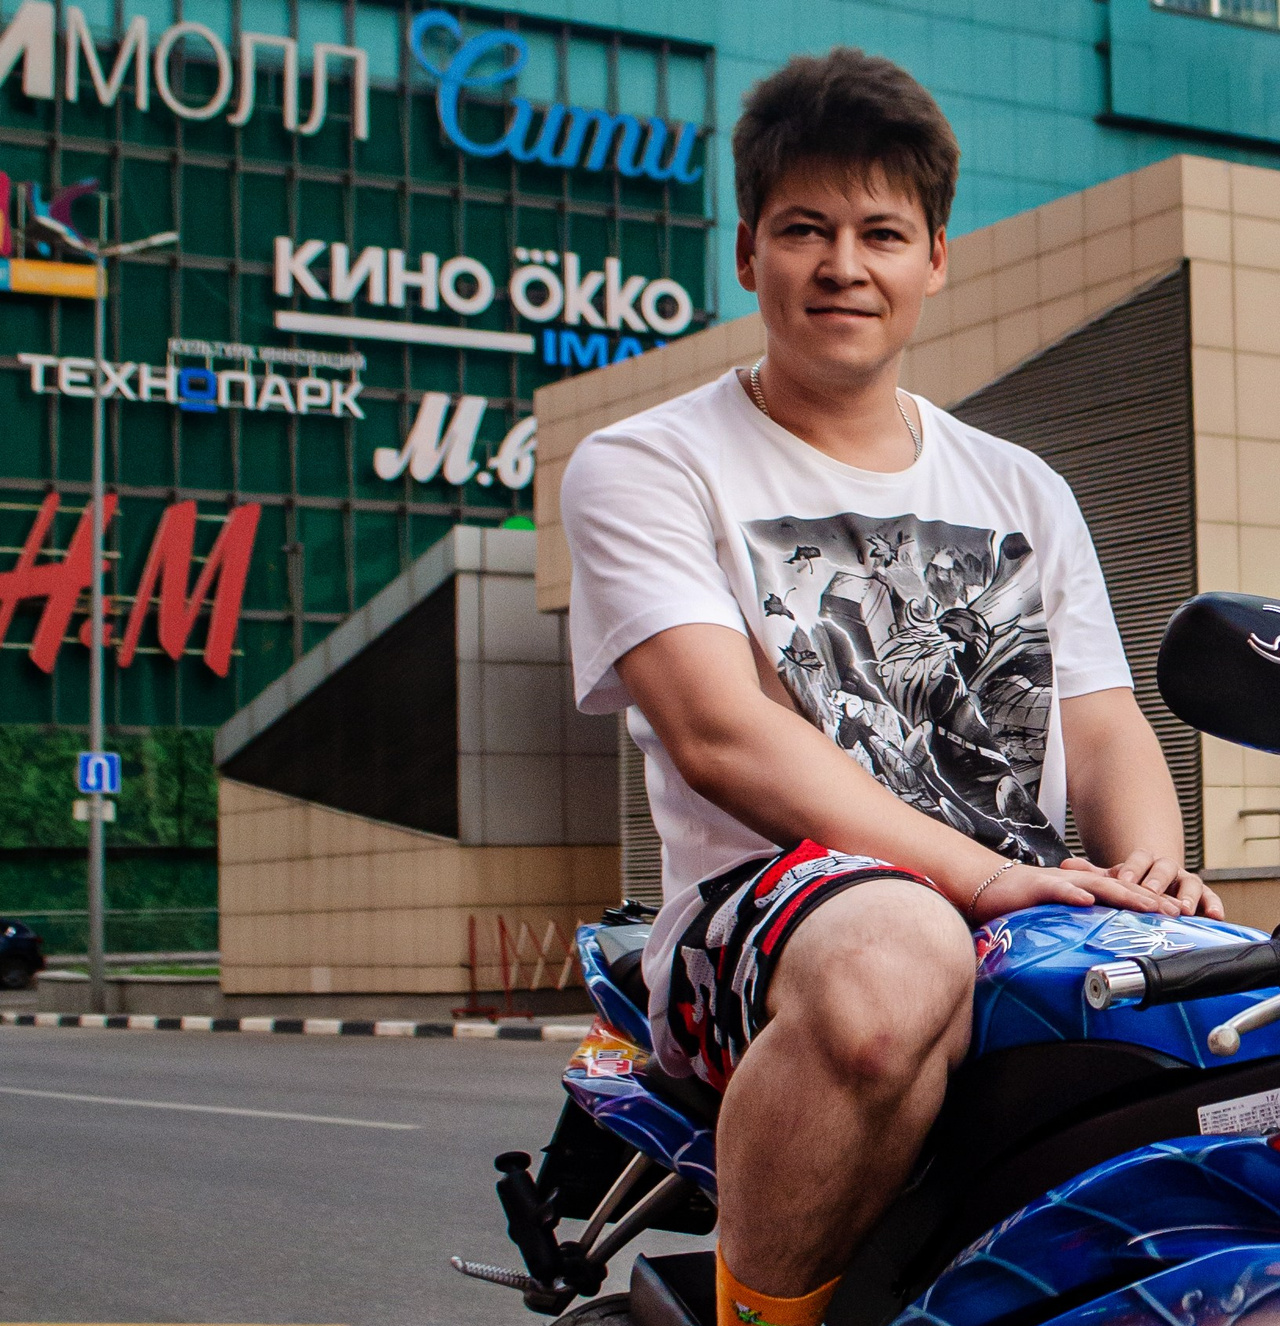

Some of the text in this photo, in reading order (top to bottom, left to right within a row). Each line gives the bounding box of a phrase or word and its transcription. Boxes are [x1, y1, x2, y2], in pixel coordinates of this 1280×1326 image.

[408, 8, 702, 184] Сити
[274, 236, 496, 315] КИНО
[542, 328, 667, 369] IMA
[17, 352, 366, 419] ТЕХНОПАРК
